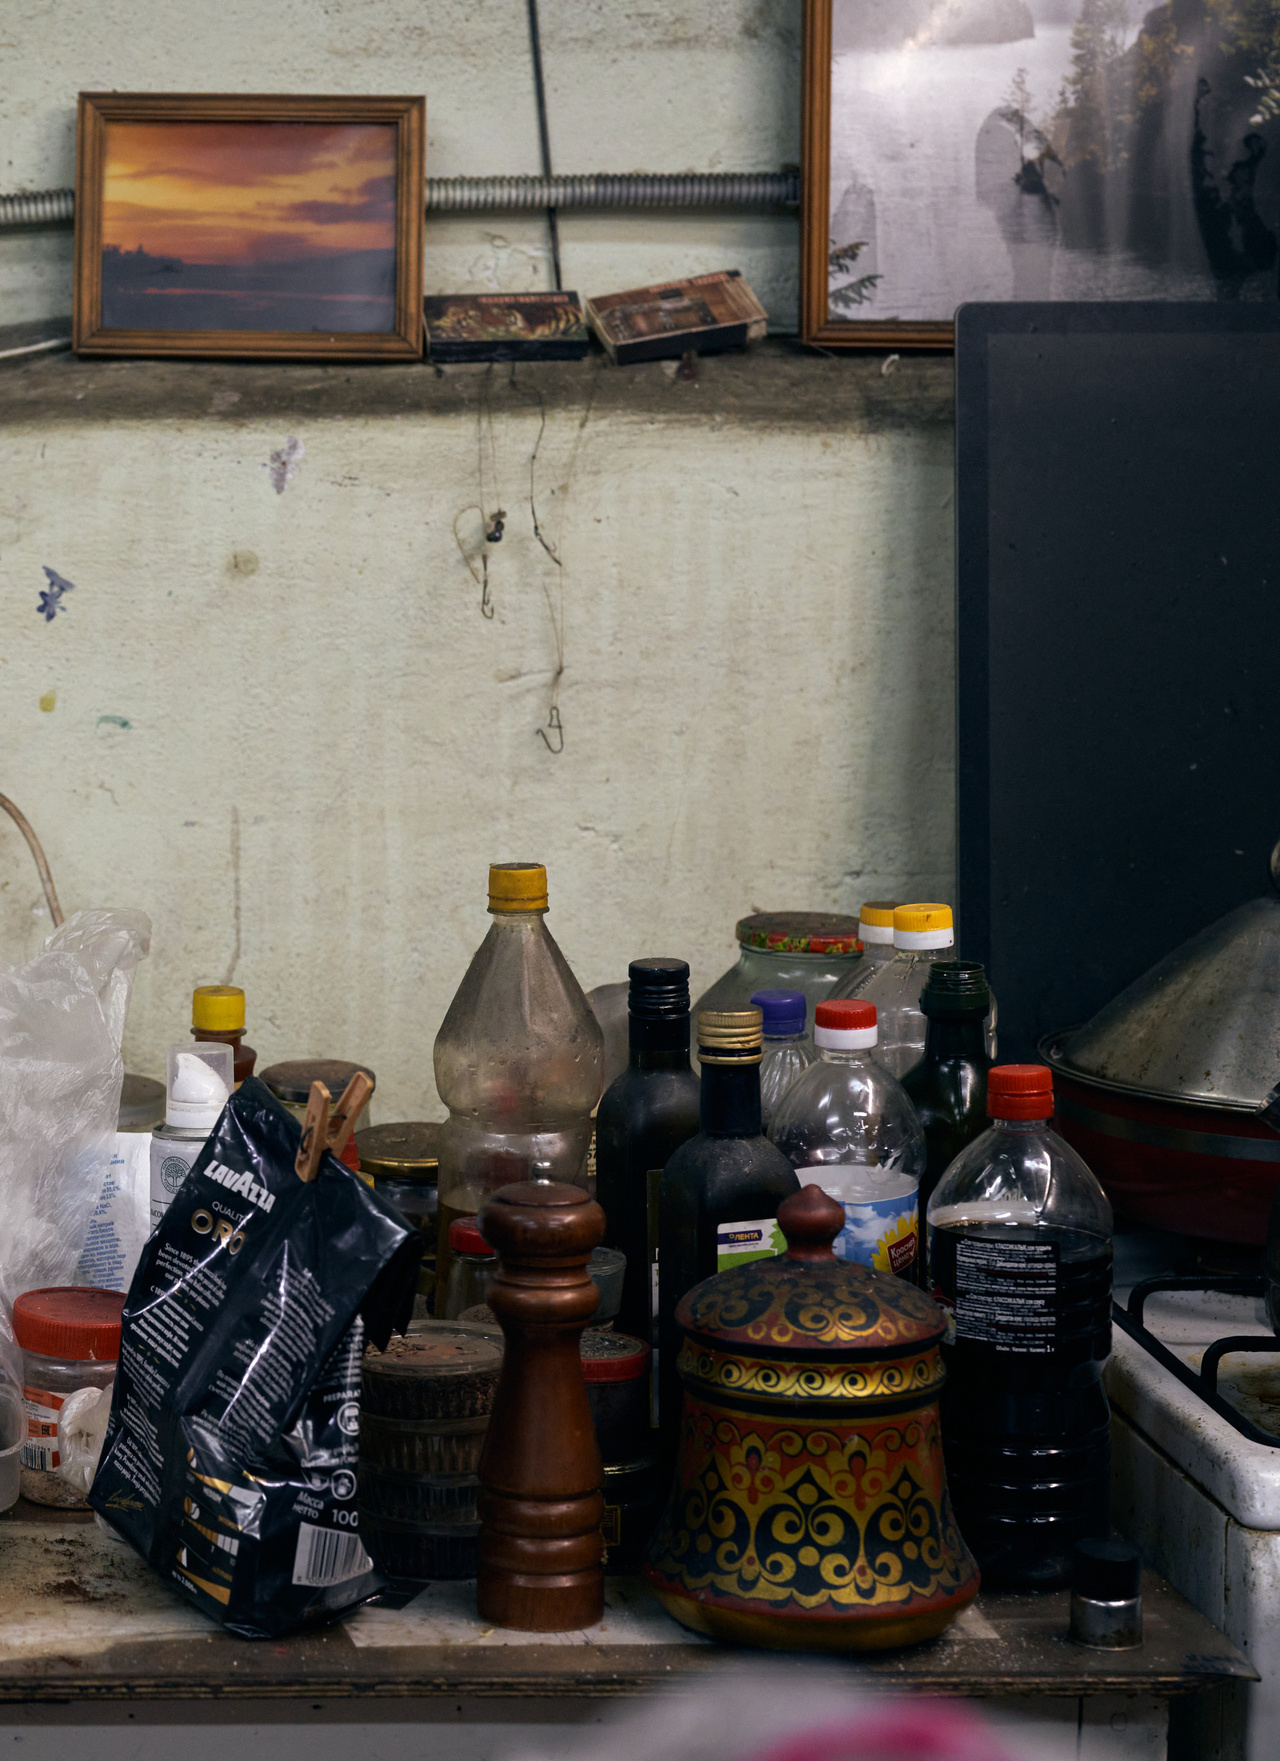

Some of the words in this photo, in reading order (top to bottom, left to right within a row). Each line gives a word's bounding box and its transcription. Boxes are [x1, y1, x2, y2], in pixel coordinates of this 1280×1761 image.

[203, 1160, 276, 1214] LAVAZZA
[211, 1201, 247, 1226] QUALIT
[191, 1208, 246, 1256] ORO
[734, 1232, 759, 1241] ЛЕНТА
[158, 1248, 172, 1261] been
[164, 1242, 179, 1256] Since
[180, 1250, 193, 1263] 1895
[297, 1491, 324, 1509] Масса
